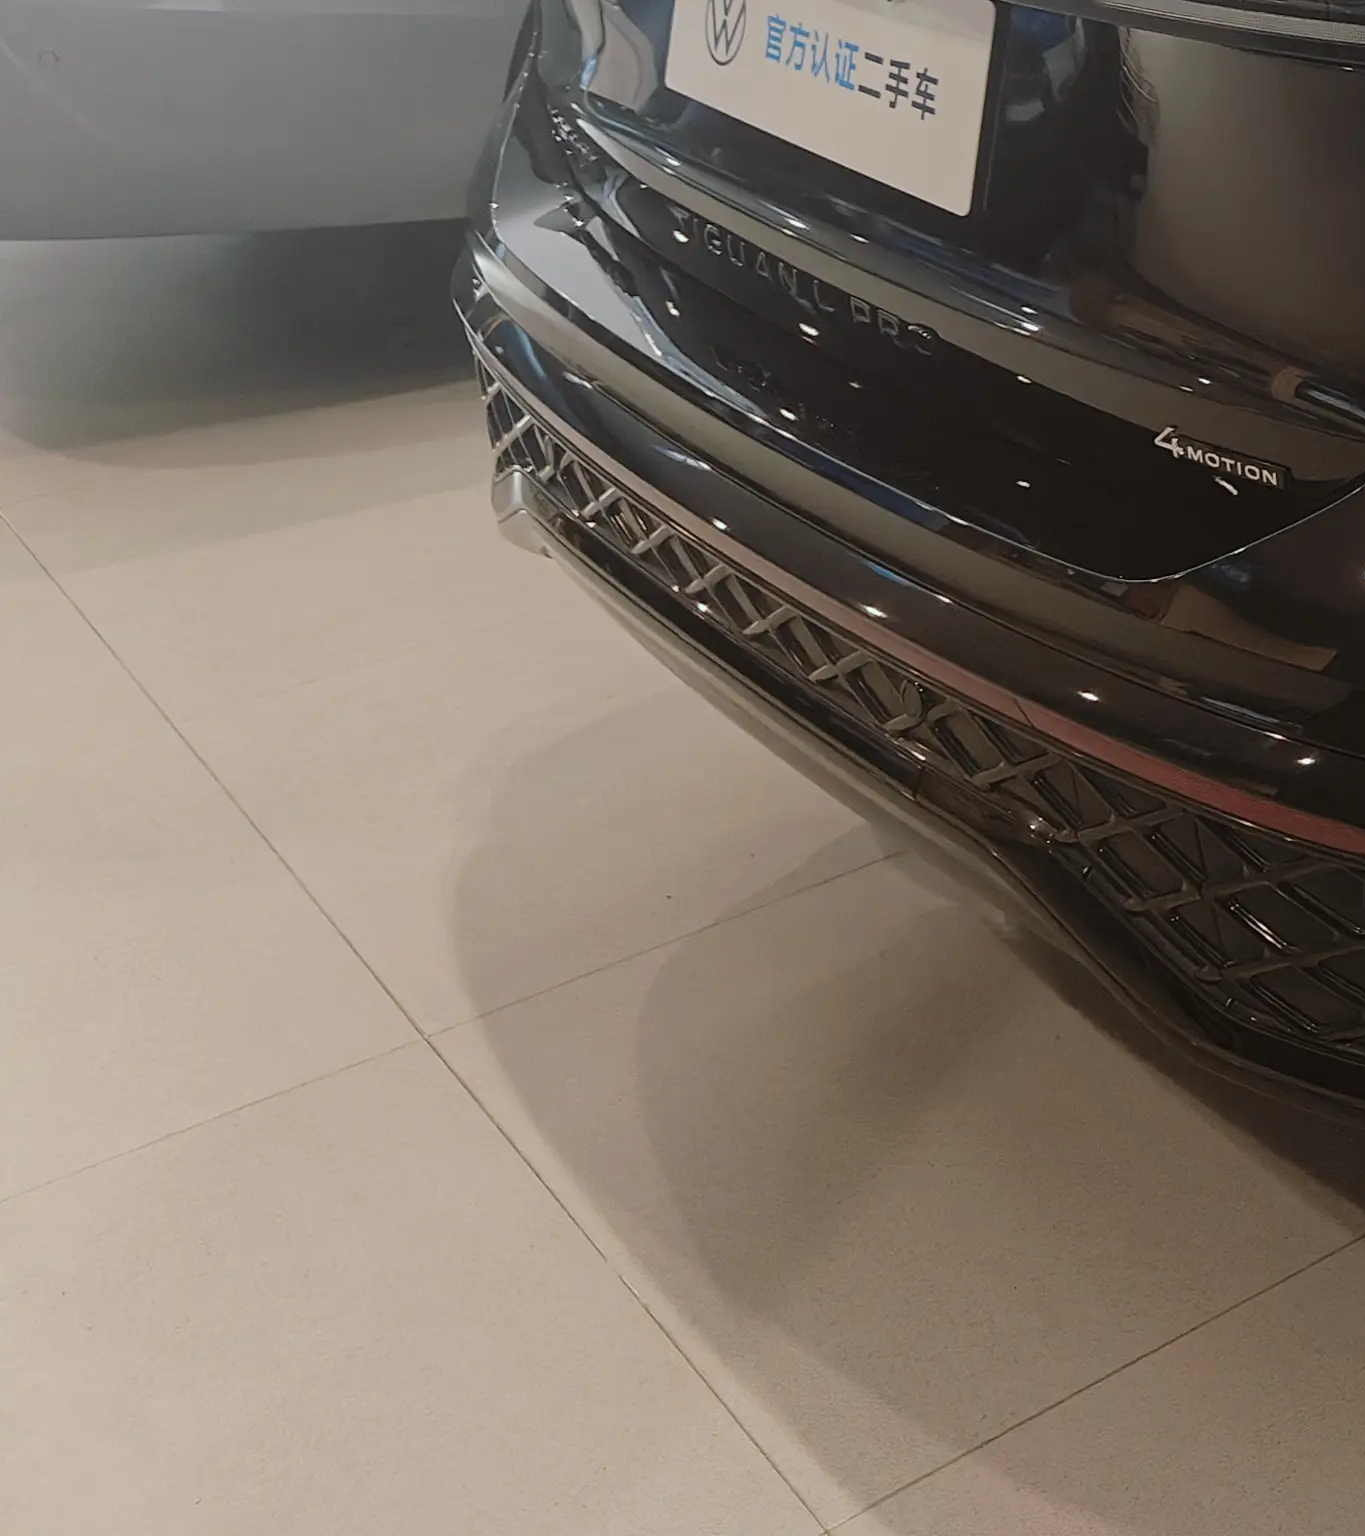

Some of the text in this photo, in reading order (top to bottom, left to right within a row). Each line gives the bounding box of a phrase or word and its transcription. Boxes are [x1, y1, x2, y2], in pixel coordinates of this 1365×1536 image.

[764, 14, 940, 121] 官方认证二手车
[1153, 426, 1278, 486] 4MOTION
